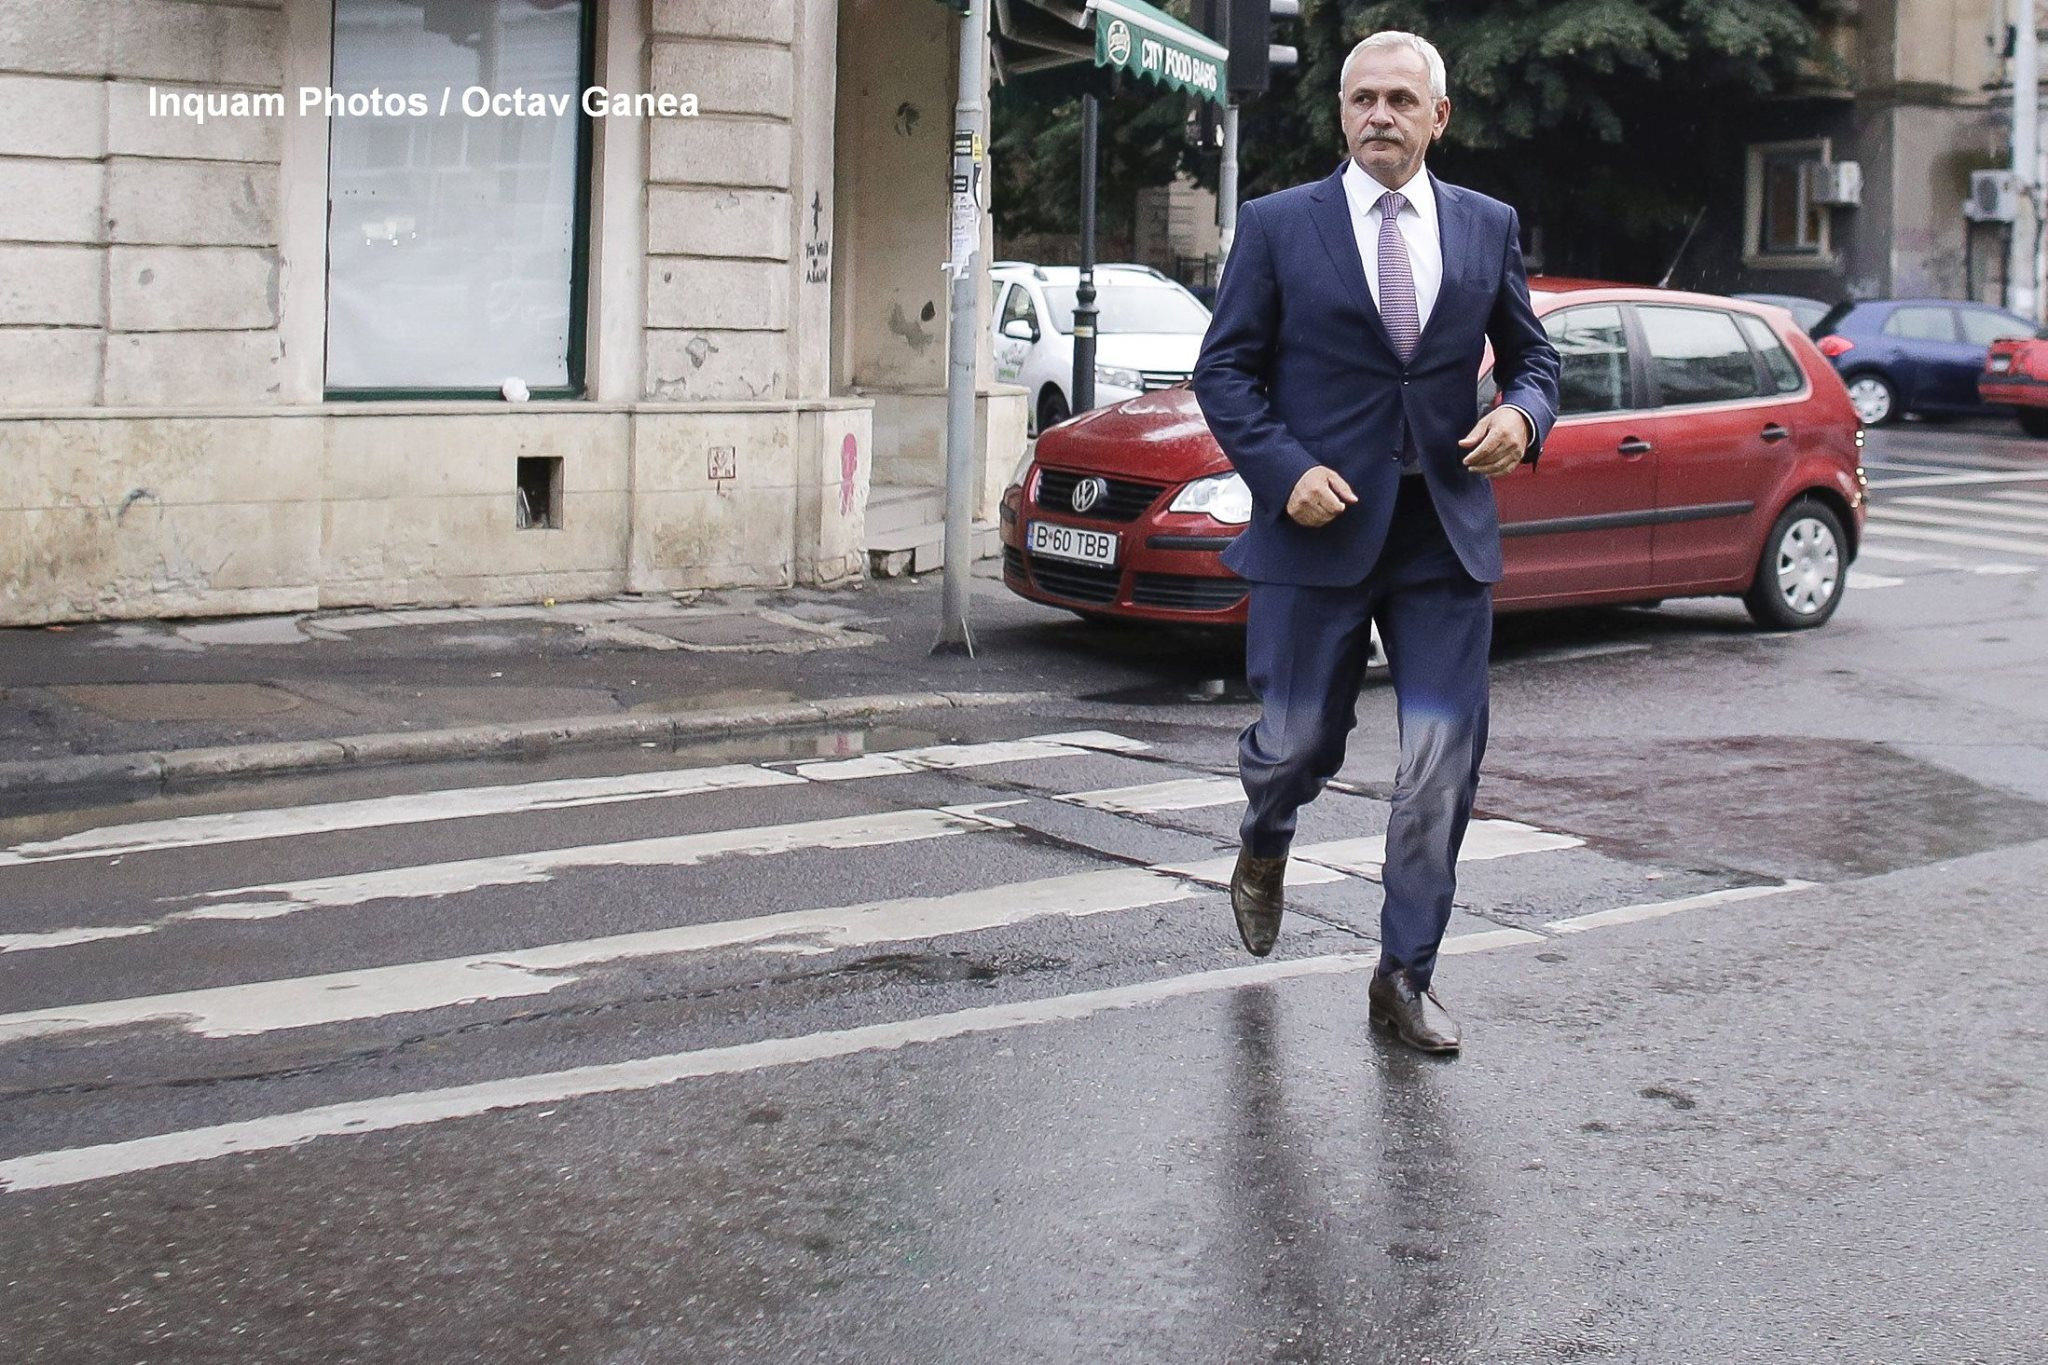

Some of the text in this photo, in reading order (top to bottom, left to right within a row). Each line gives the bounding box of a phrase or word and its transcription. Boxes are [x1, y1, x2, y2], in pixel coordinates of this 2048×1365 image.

[1141, 38, 1164, 70] CITY
[1165, 46, 1192, 82] FOOD
[1193, 58, 1217, 92] BARS
[1036, 526, 1110, 558] B 60 TBB
